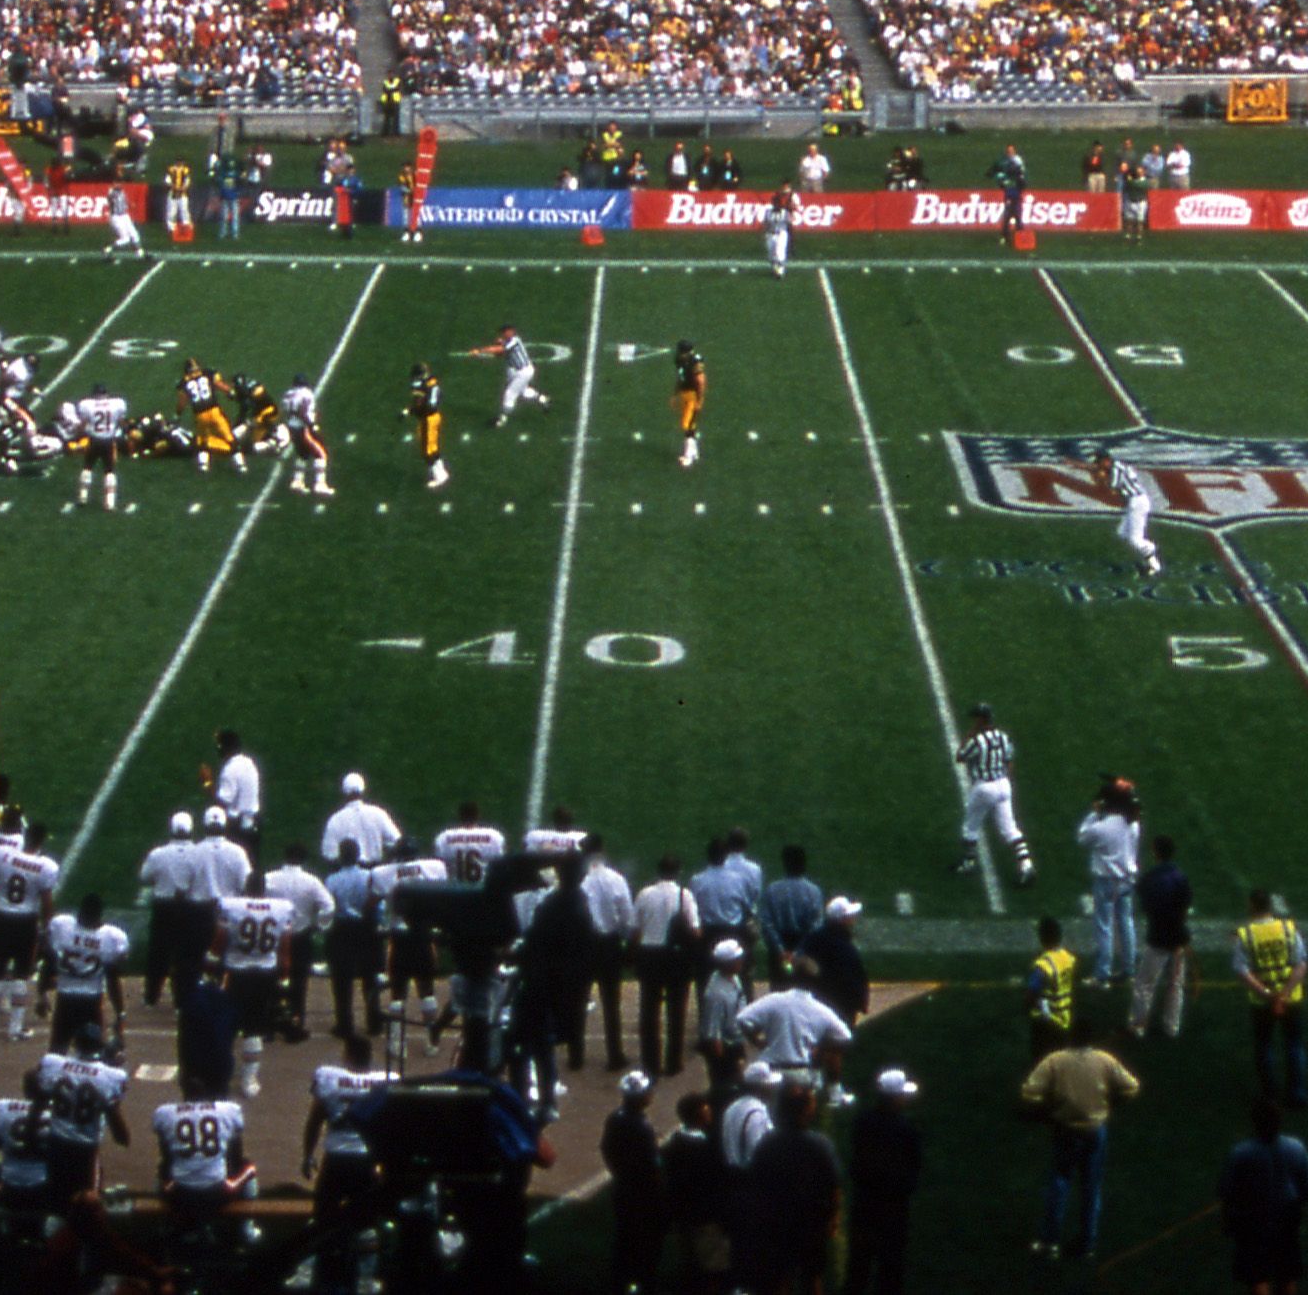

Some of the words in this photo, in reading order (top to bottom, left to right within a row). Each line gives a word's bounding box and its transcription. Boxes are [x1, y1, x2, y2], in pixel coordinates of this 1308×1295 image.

[255, 191, 334, 221] Sprint
[420, 206, 525, 224] WATERFORD
[529, 208, 602, 224] CRYSTAL
[911, 193, 1087, 225] Budwiser
[1180, 197, 1246, 221] Heinz
[186, 375, 212, 404] 38
[93, 409, 112, 434] 21
[436, 631, 687, 668] 40
[455, 849, 482, 882] 16
[7, 874, 25, 903] 8
[239, 917, 278, 954] 96
[175, 1116, 220, 1158] 98
